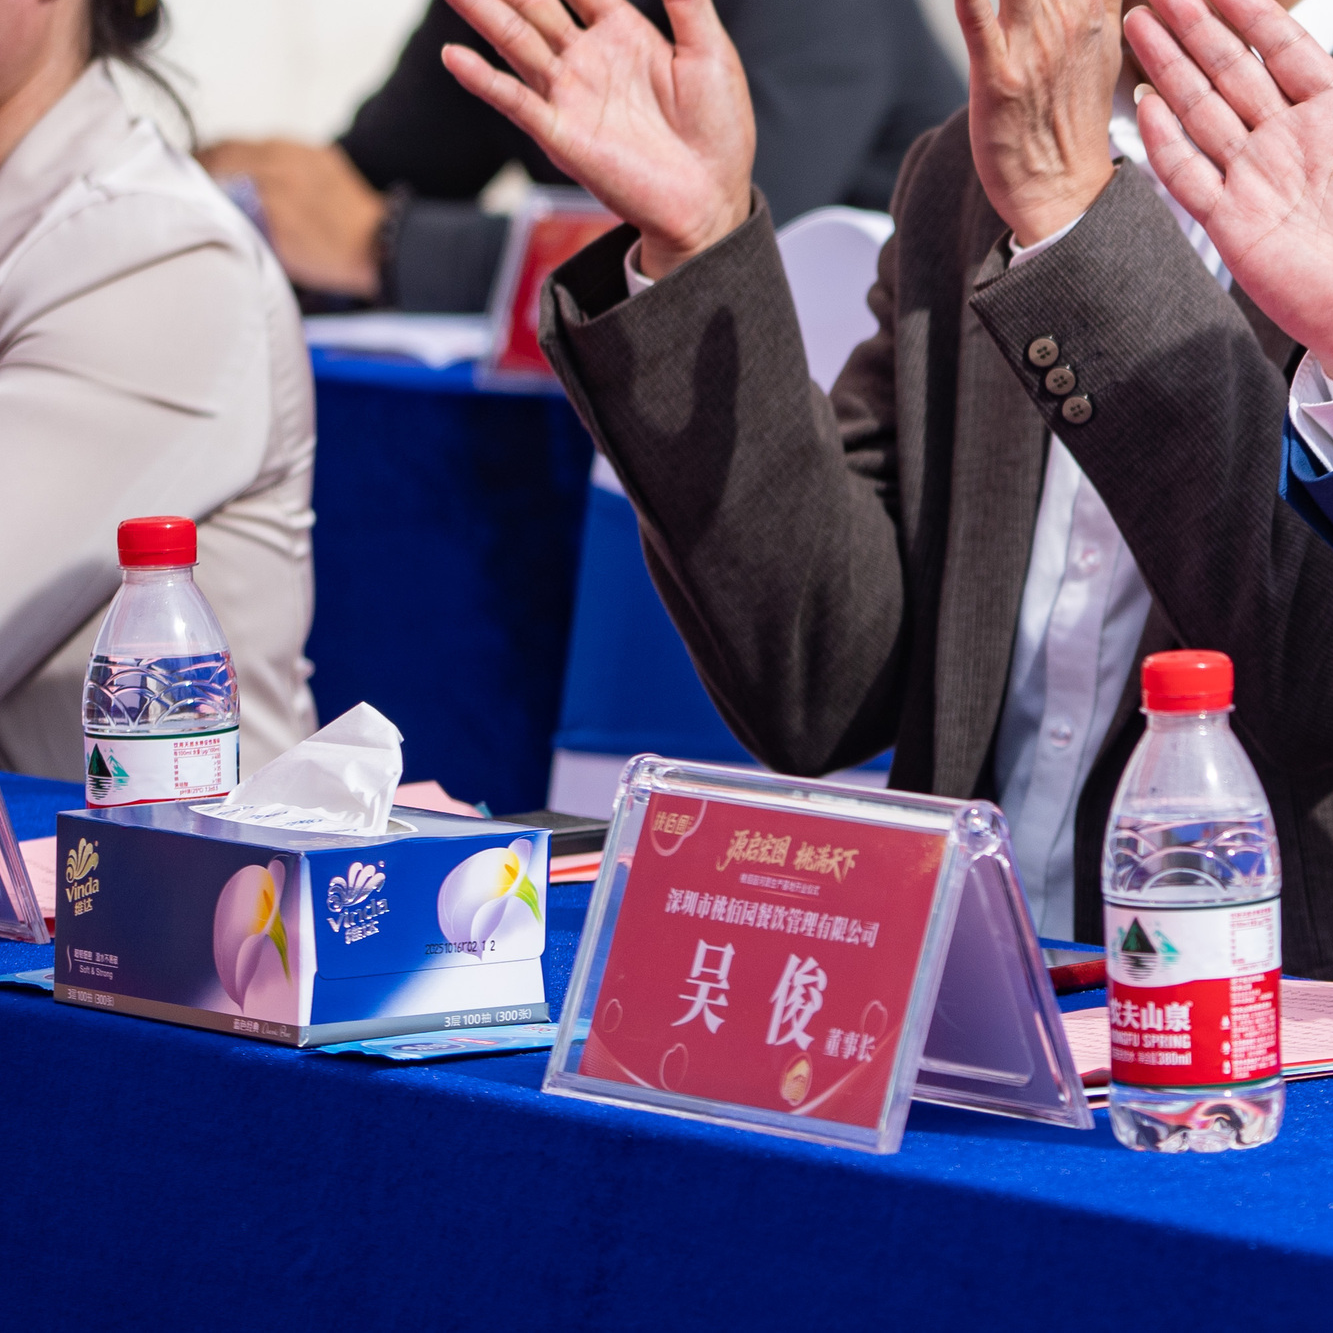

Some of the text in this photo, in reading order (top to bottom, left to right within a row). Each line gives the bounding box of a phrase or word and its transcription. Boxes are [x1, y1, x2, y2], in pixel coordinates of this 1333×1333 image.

[664, 887, 880, 949] 深圳市桃佰园餐饮管理有限公司
[823, 1027, 877, 1063] 董事长
[1142, 1032, 1192, 1050] SPRING
